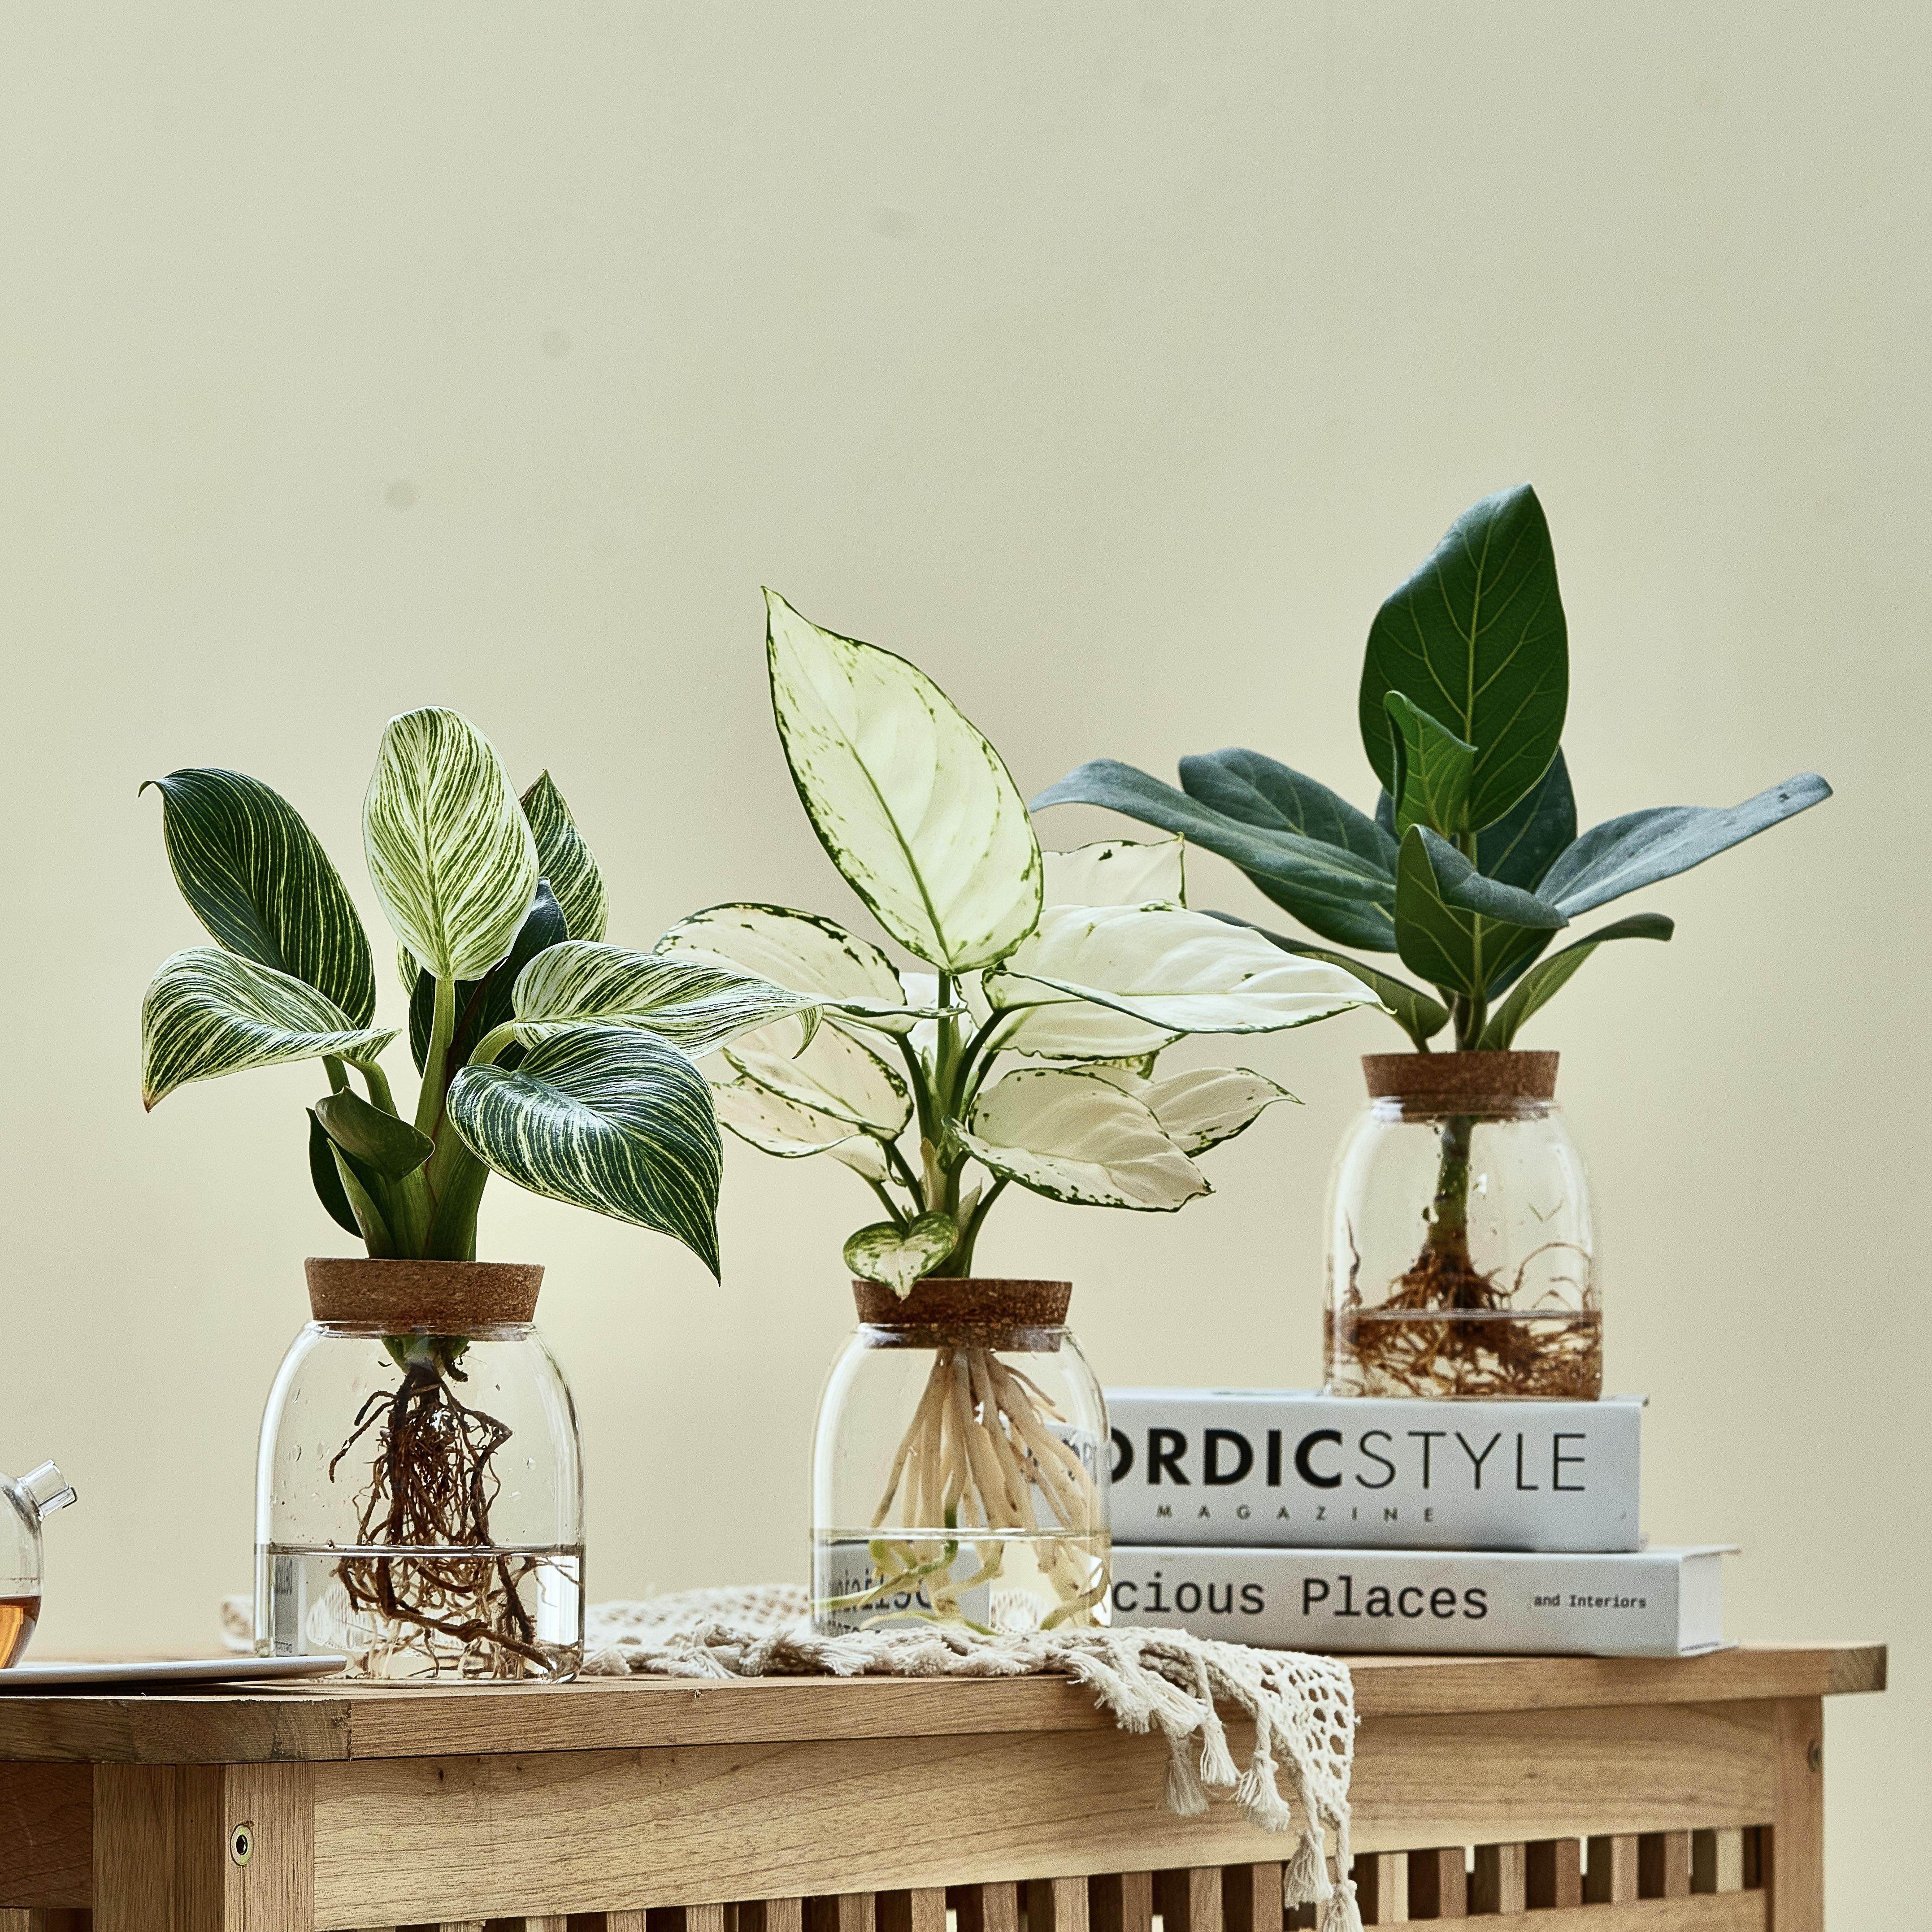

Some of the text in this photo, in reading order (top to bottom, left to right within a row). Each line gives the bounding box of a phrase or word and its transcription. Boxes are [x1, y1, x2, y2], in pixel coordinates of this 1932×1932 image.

[1156, 1505, 1434, 1523] MAGAZINE
[1302, 1574, 1488, 1620] Places
[1533, 1593, 1647, 1609] and Interiors
